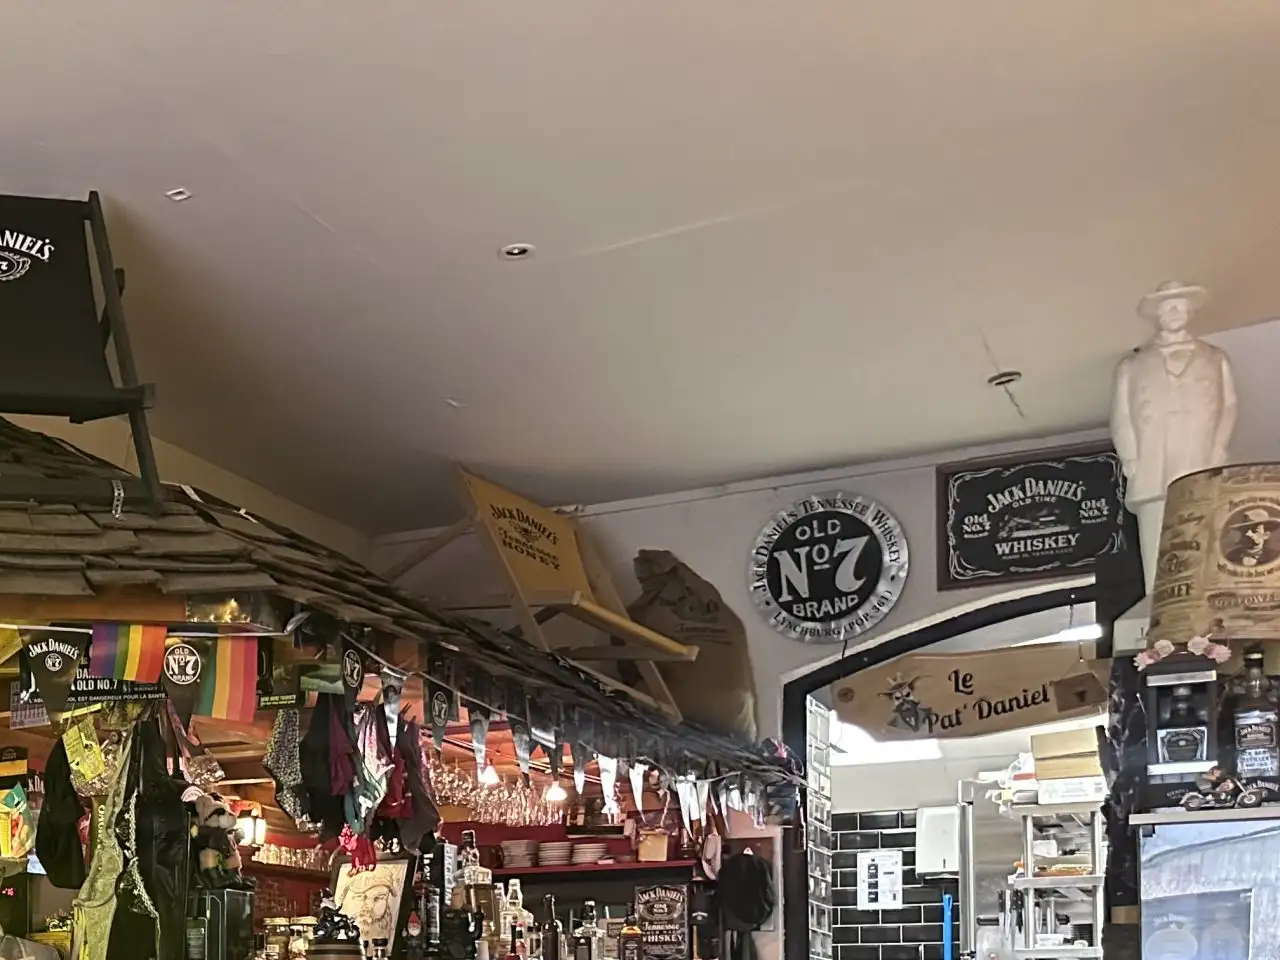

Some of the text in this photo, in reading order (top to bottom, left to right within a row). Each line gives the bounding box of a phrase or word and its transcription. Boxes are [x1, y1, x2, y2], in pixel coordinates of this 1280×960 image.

[987, 477, 1086, 514] JACK DANIEL'S
[1012, 497, 1032, 508] OLD
[1080, 498, 1107, 510] Old
[963, 514, 989, 524] Old
[1078, 507, 1110, 519] No.7
[489, 503, 560, 546] JACK DANIEL'S
[795, 519, 841, 540] OLD
[962, 522, 992, 533] No.7
[501, 539, 561, 570] HONEY
[752, 498, 901, 593] JACK DANIEL'S TENNESSEE WHISKEY
[995, 533, 1081, 556] WHISKEY
[792, 594, 859, 619] BRAND
[773, 610, 841, 638] LYNCHBURG
[28, 638, 80, 661] JACK DANIEL'S
[175, 648, 189, 656] OLD
[76, 679, 118, 691] OLD NO.7
[949, 668, 974, 696] Le
[638, 889, 656, 904] JACK
[642, 921, 680, 931] Tennessee
